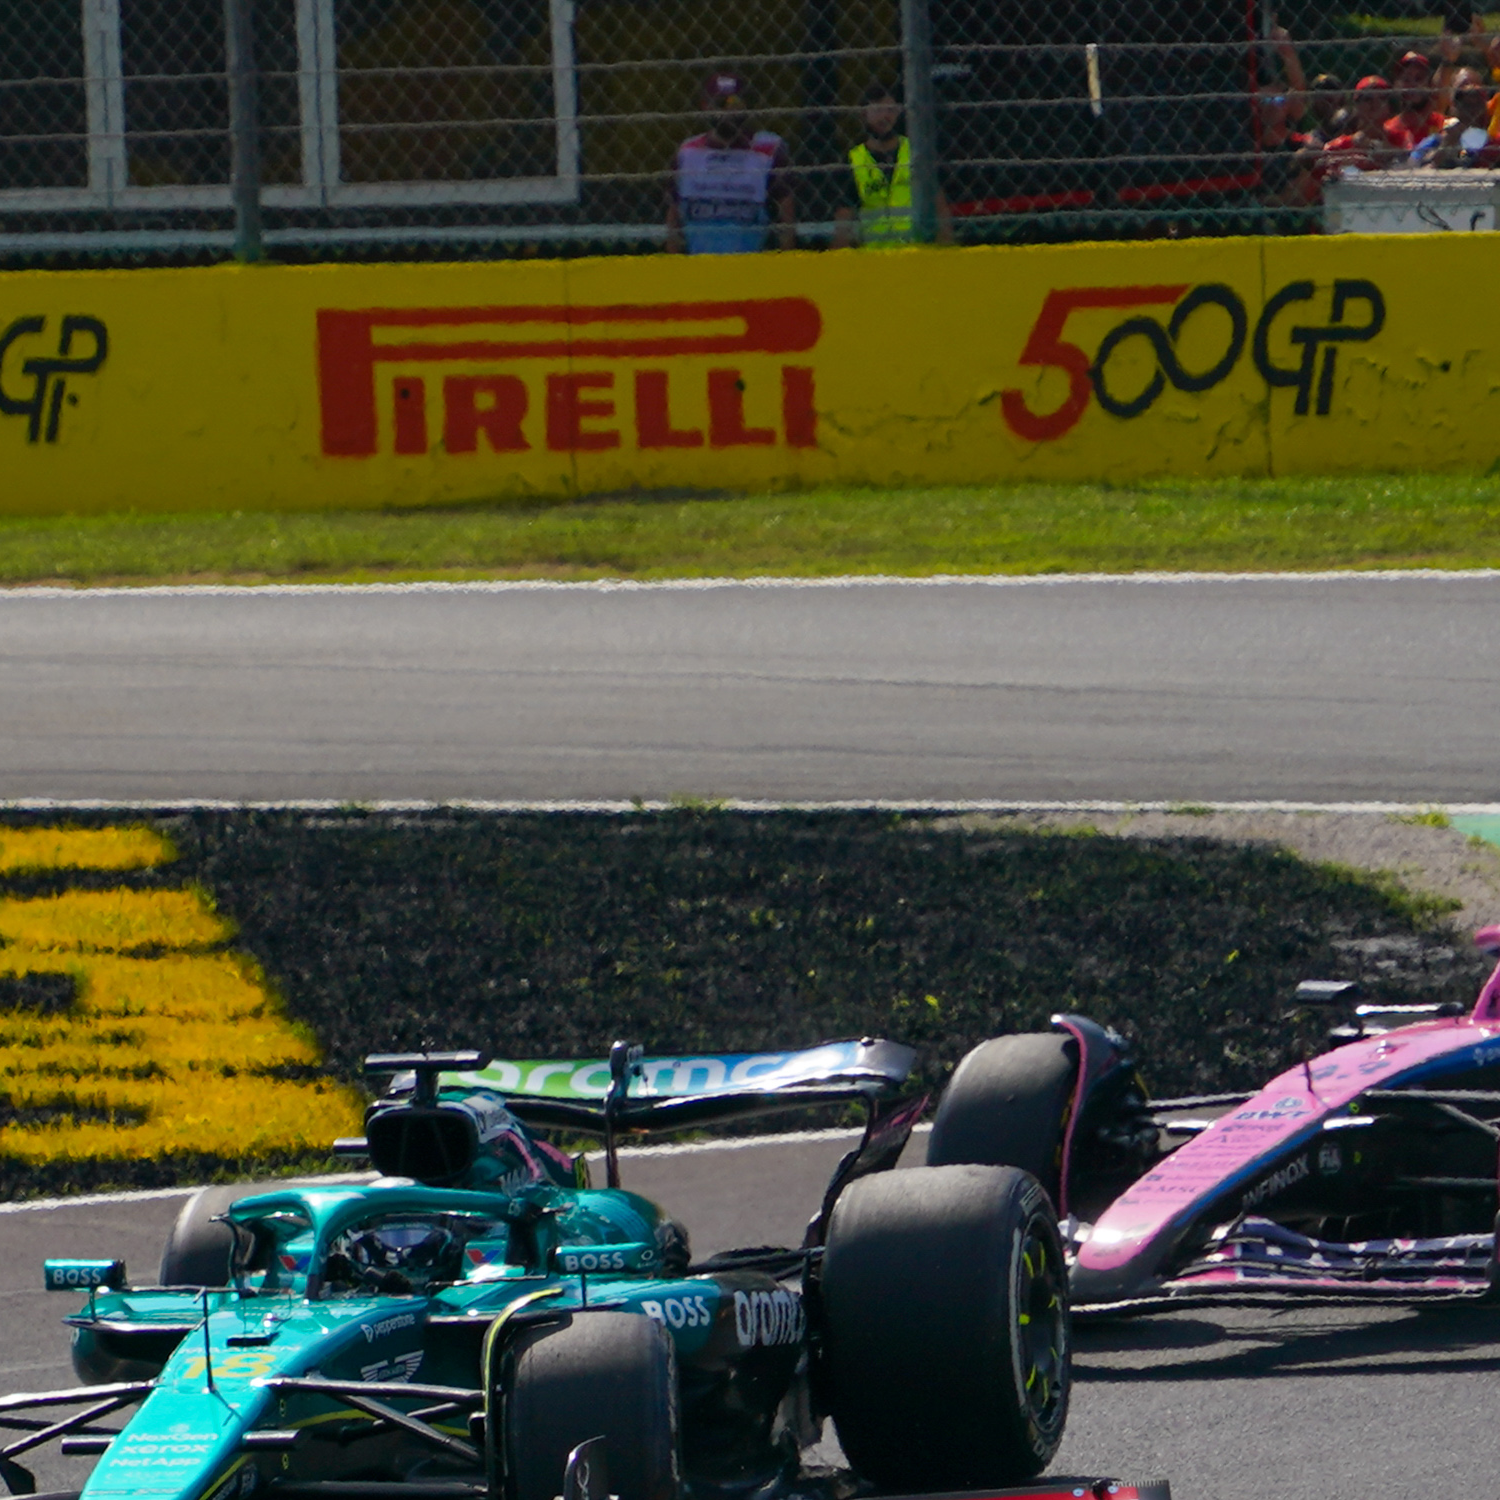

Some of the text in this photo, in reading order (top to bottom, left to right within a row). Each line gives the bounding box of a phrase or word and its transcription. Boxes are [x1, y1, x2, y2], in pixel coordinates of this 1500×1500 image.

[316, 296, 822, 457] PIRELLI
[565, 1251, 625, 1272] BOSS
[53, 1268, 101, 1286] BOSS
[641, 1296, 710, 1329] BOSS
[182, 1353, 277, 1379] 18
[127, 1432, 219, 1443] NexGen
[119, 1444, 210, 1454] xerox
[109, 1457, 201, 1468] NetApp
